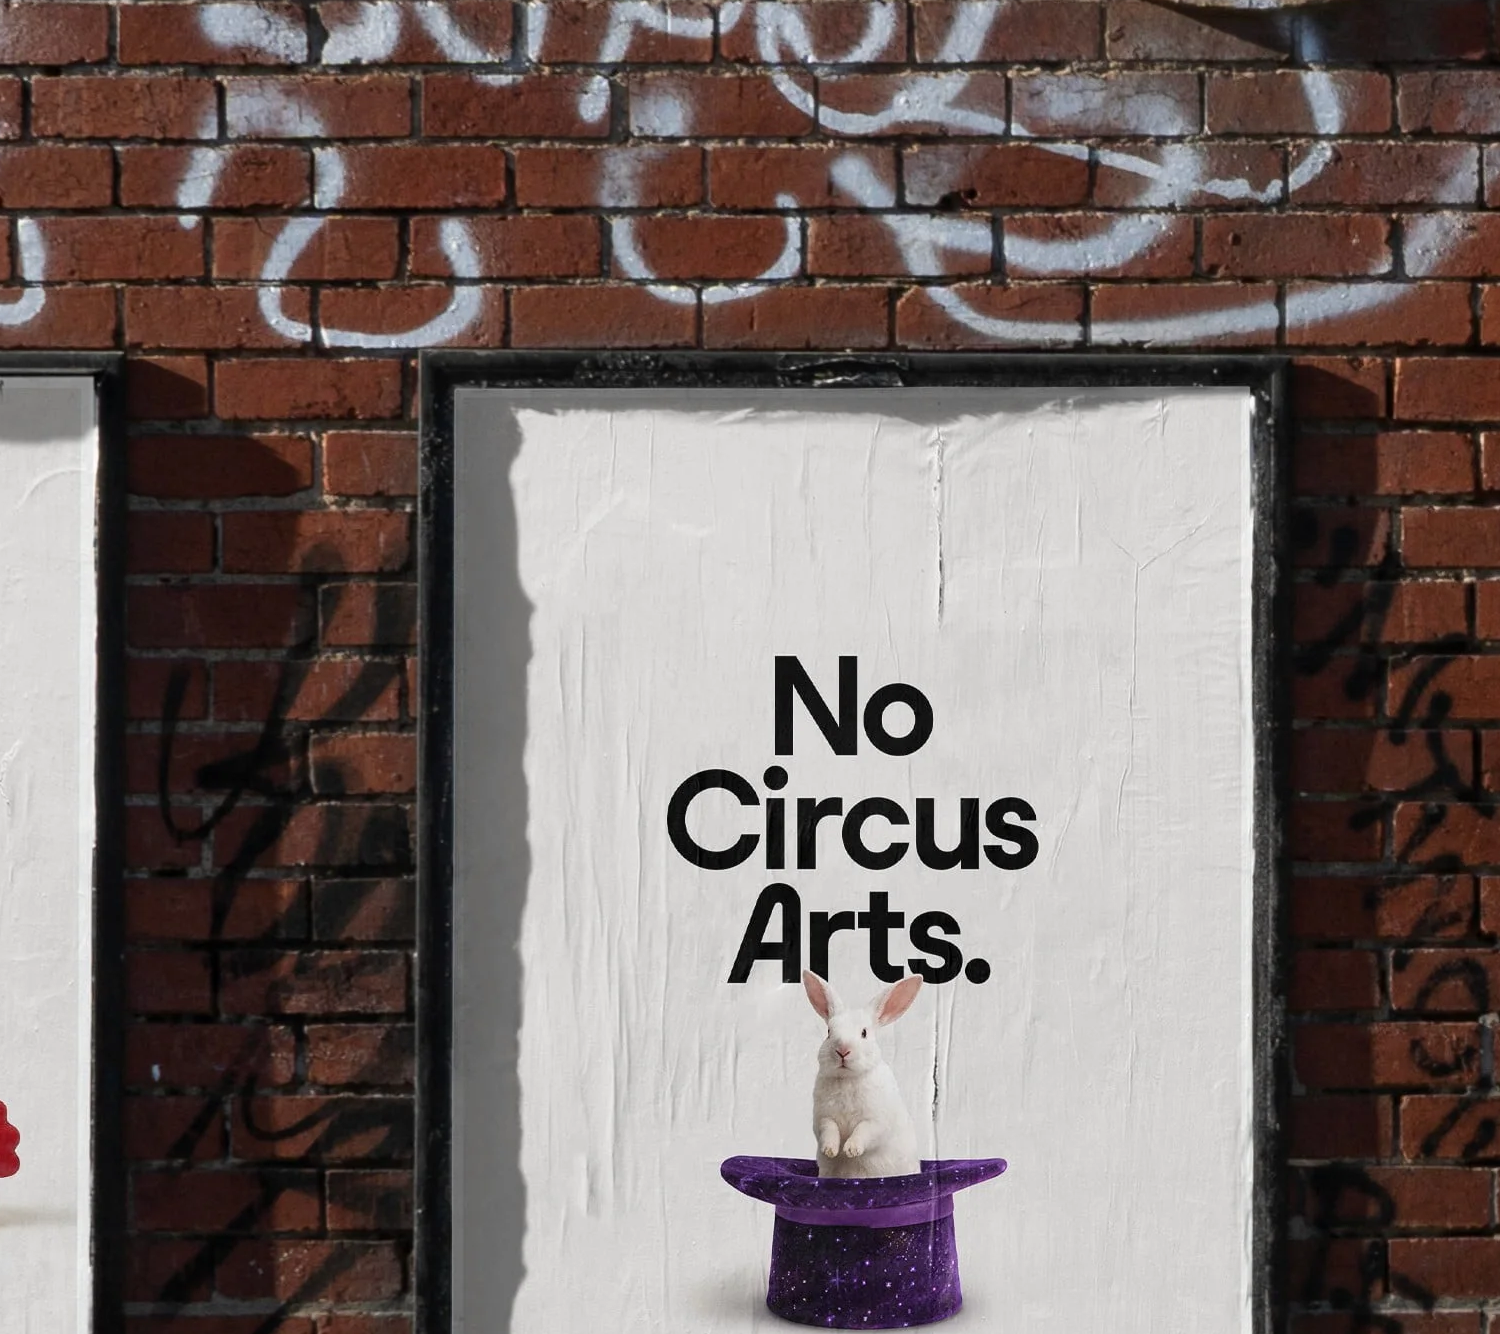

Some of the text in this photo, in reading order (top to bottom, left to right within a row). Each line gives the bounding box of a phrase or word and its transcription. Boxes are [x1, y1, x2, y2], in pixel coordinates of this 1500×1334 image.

[775, 655, 933, 756] No
[667, 765, 1039, 871] Circus
[726, 882, 991, 985] Arts.
